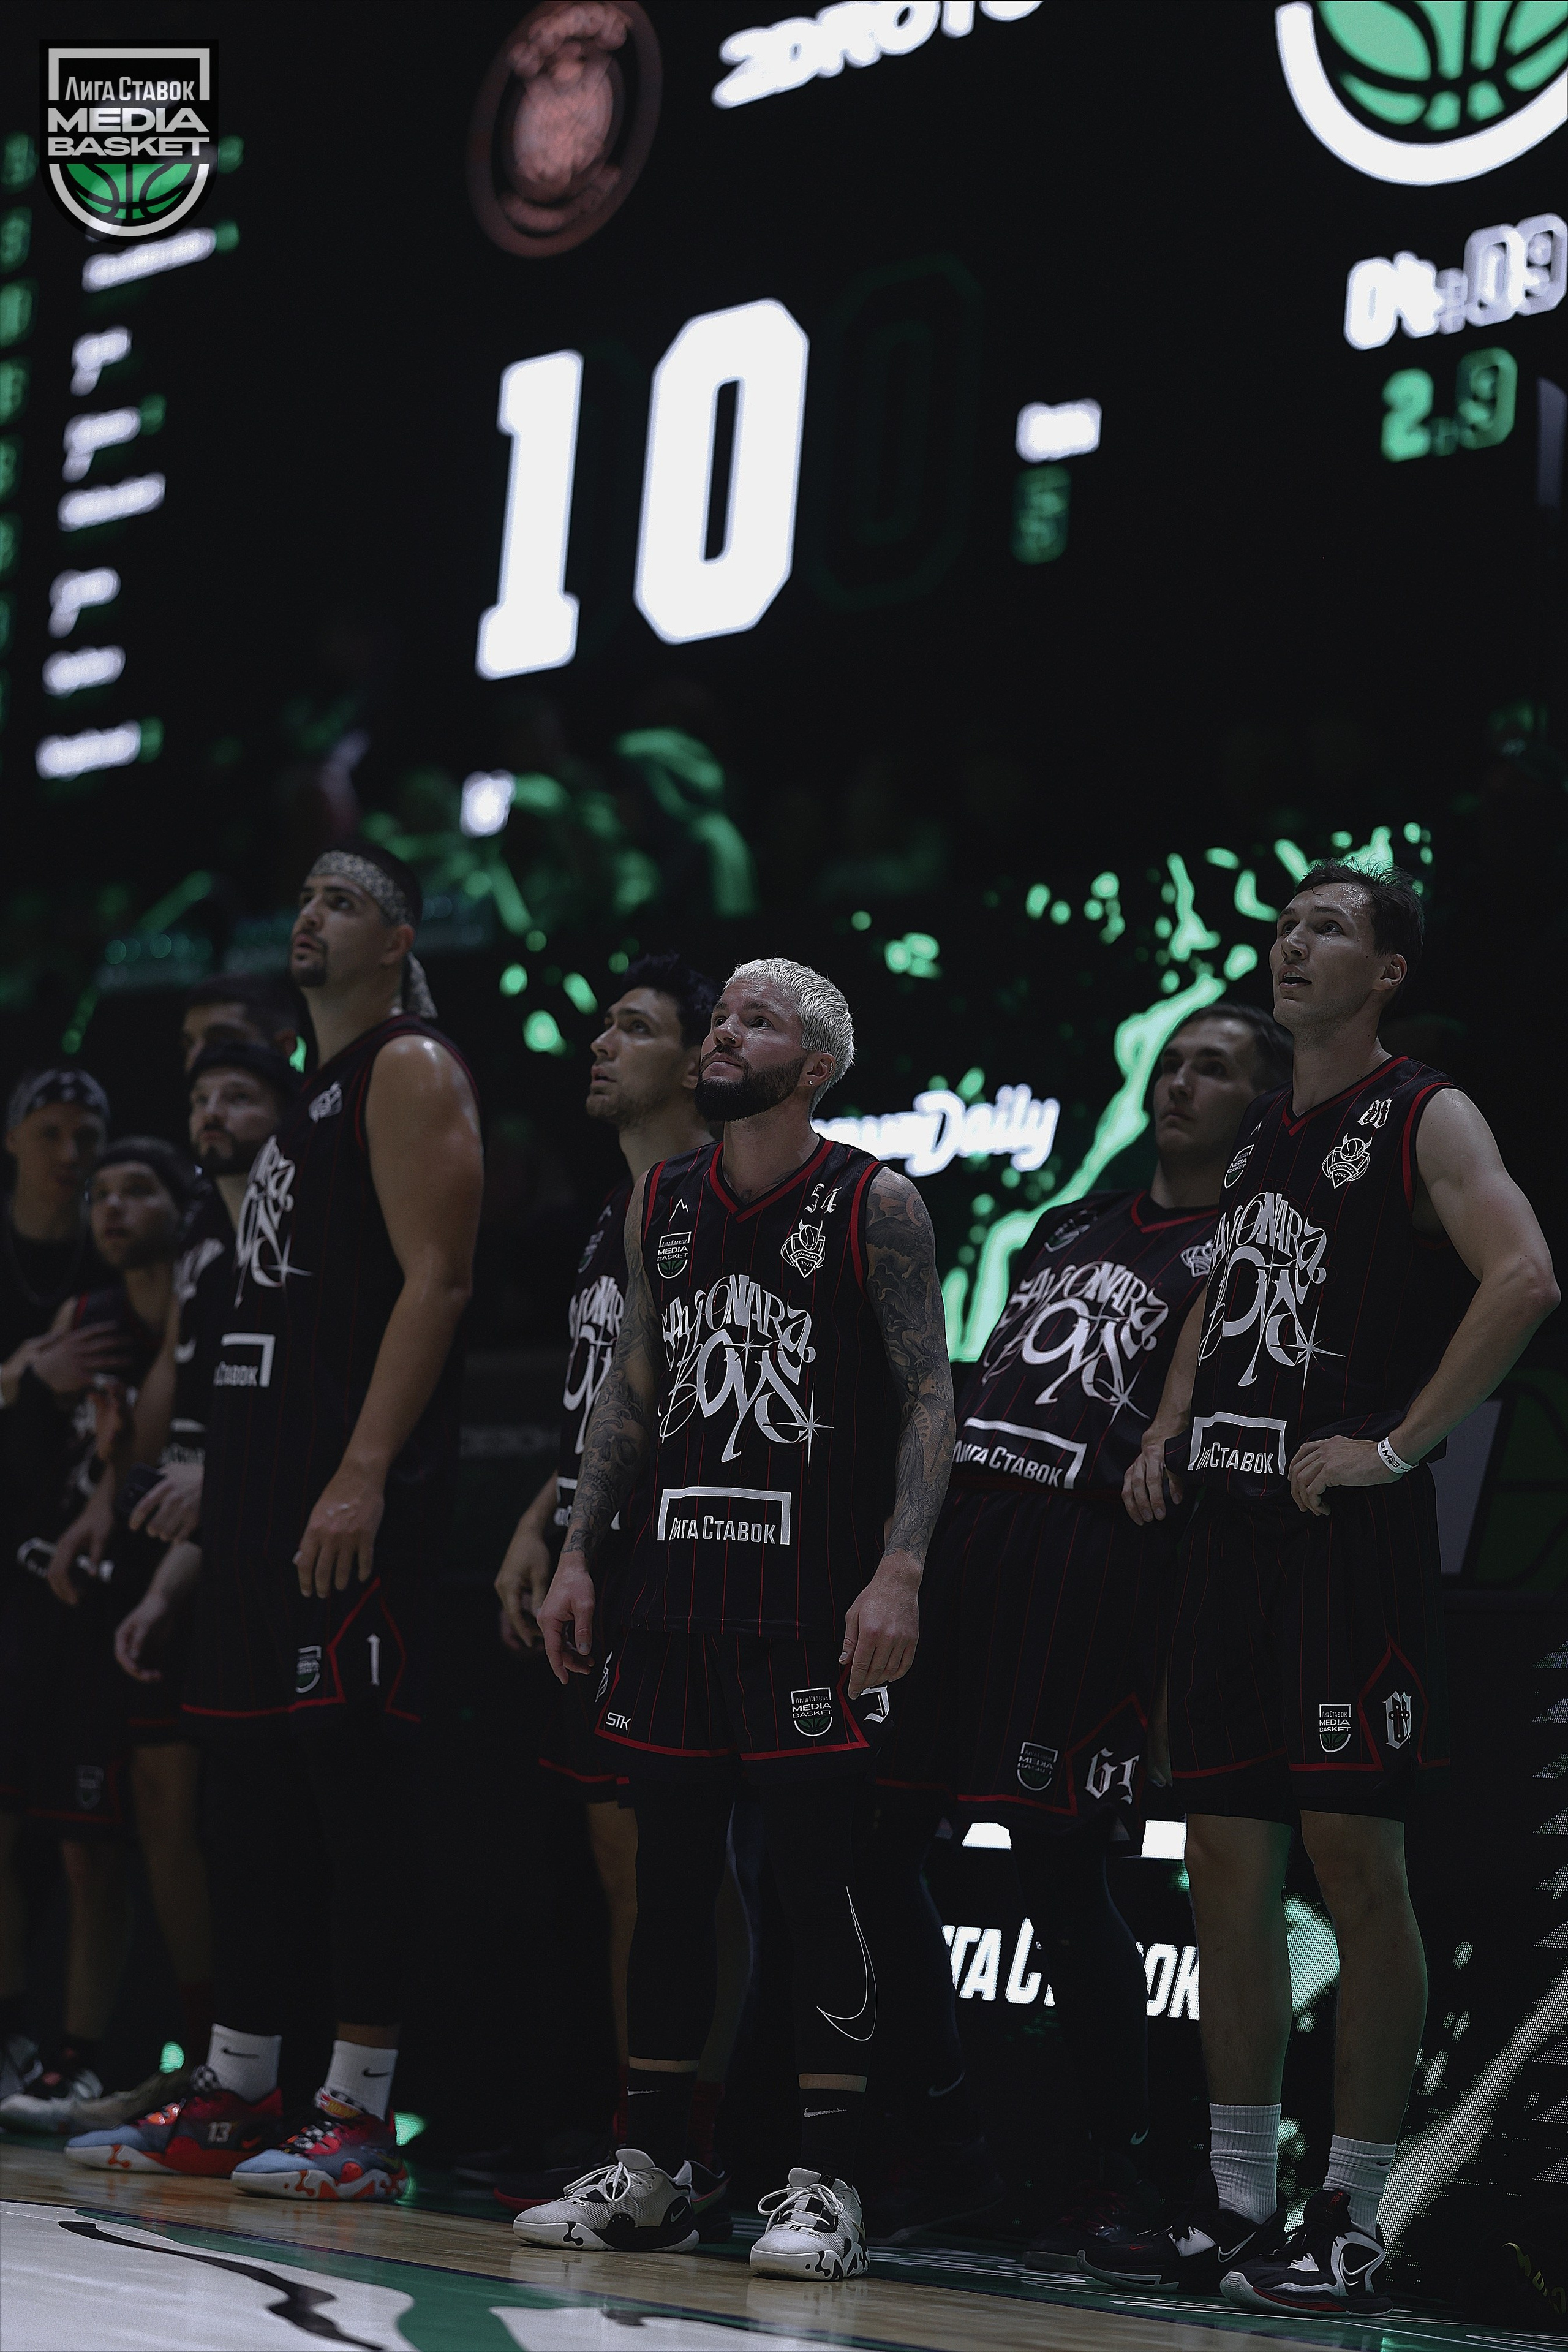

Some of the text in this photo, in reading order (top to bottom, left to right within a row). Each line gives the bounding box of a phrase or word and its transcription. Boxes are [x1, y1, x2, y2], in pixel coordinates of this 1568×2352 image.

[475, 298, 810, 680] 10
[658, 1246, 688, 1256] MEDIA
[657, 1252, 688, 1262] BASKET
[791, 1702, 832, 1712] MEDIA
[793, 1709, 832, 1719] BASKET
[605, 1712, 632, 1731] STK
